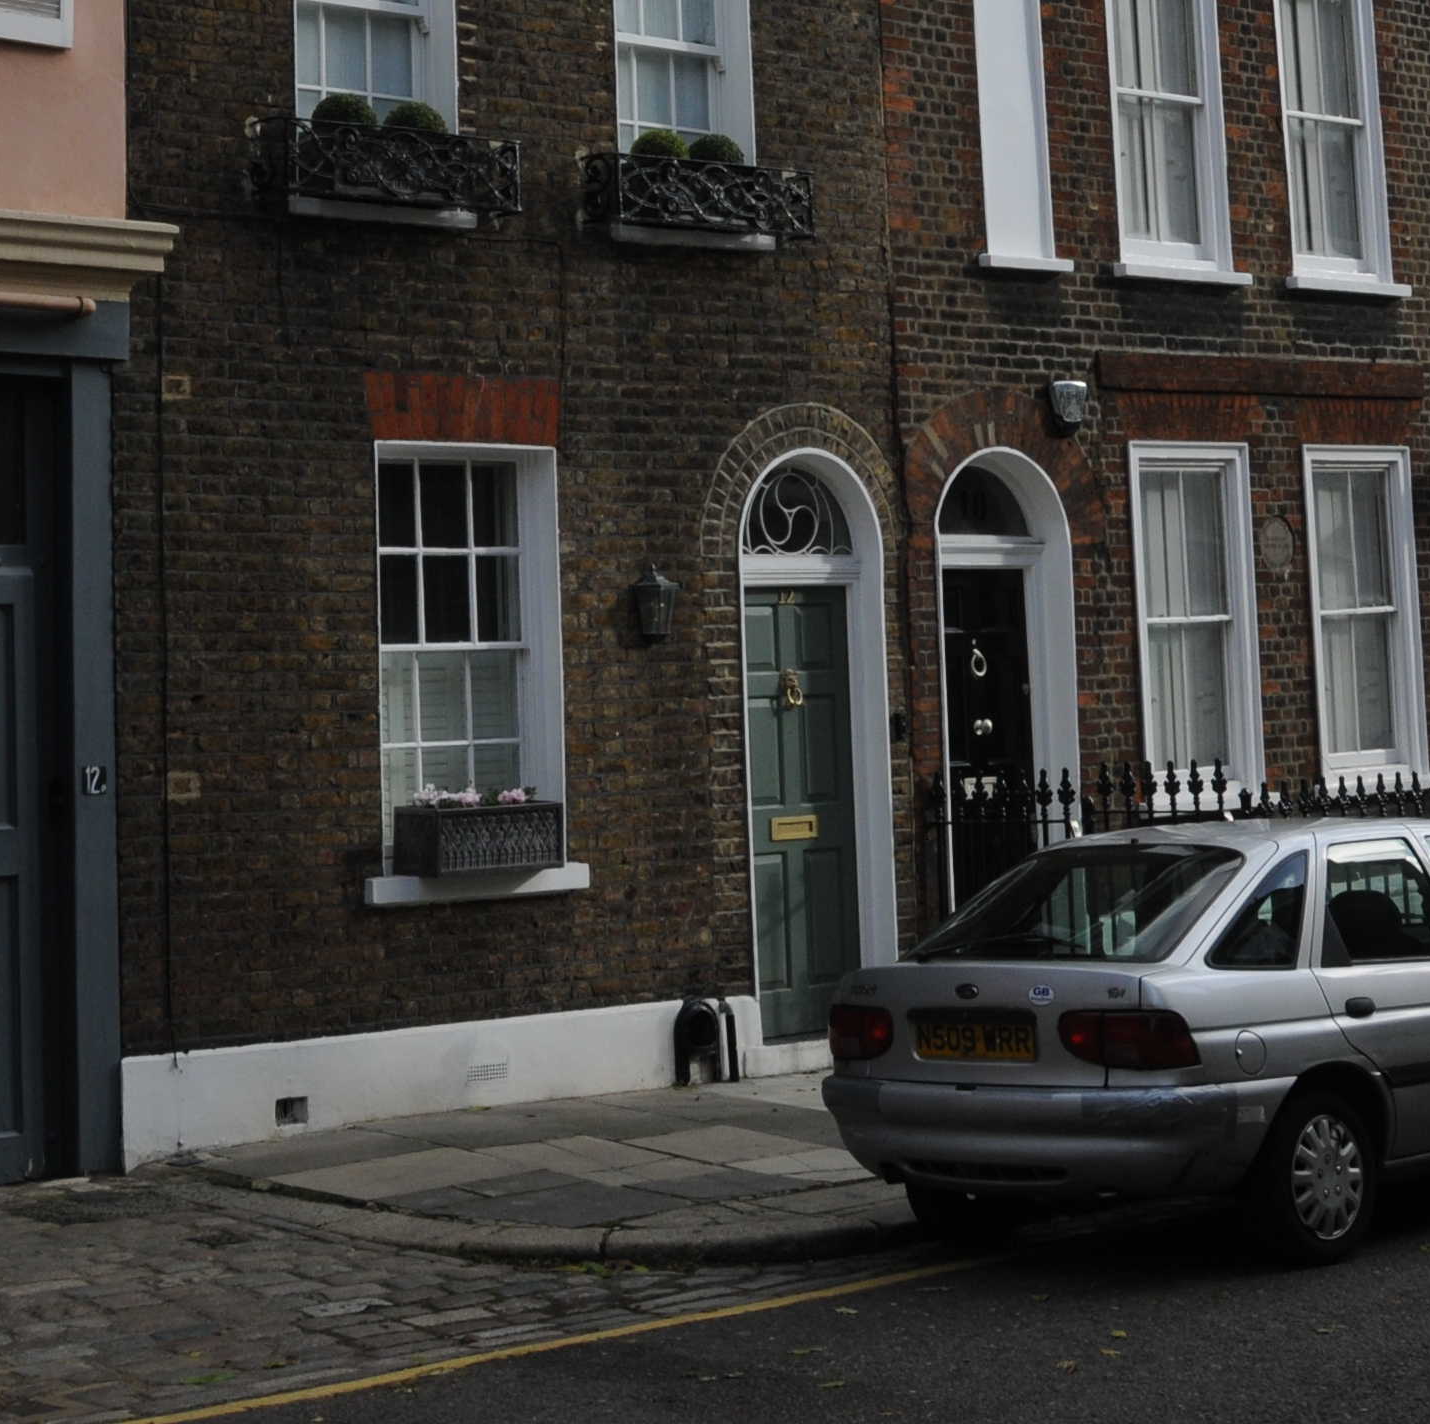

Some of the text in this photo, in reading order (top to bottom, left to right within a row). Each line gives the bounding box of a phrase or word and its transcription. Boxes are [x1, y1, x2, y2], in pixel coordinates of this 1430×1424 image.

[1033, 986, 1050, 996] GB
[917, 1023, 1032, 1053] N509 WRR
